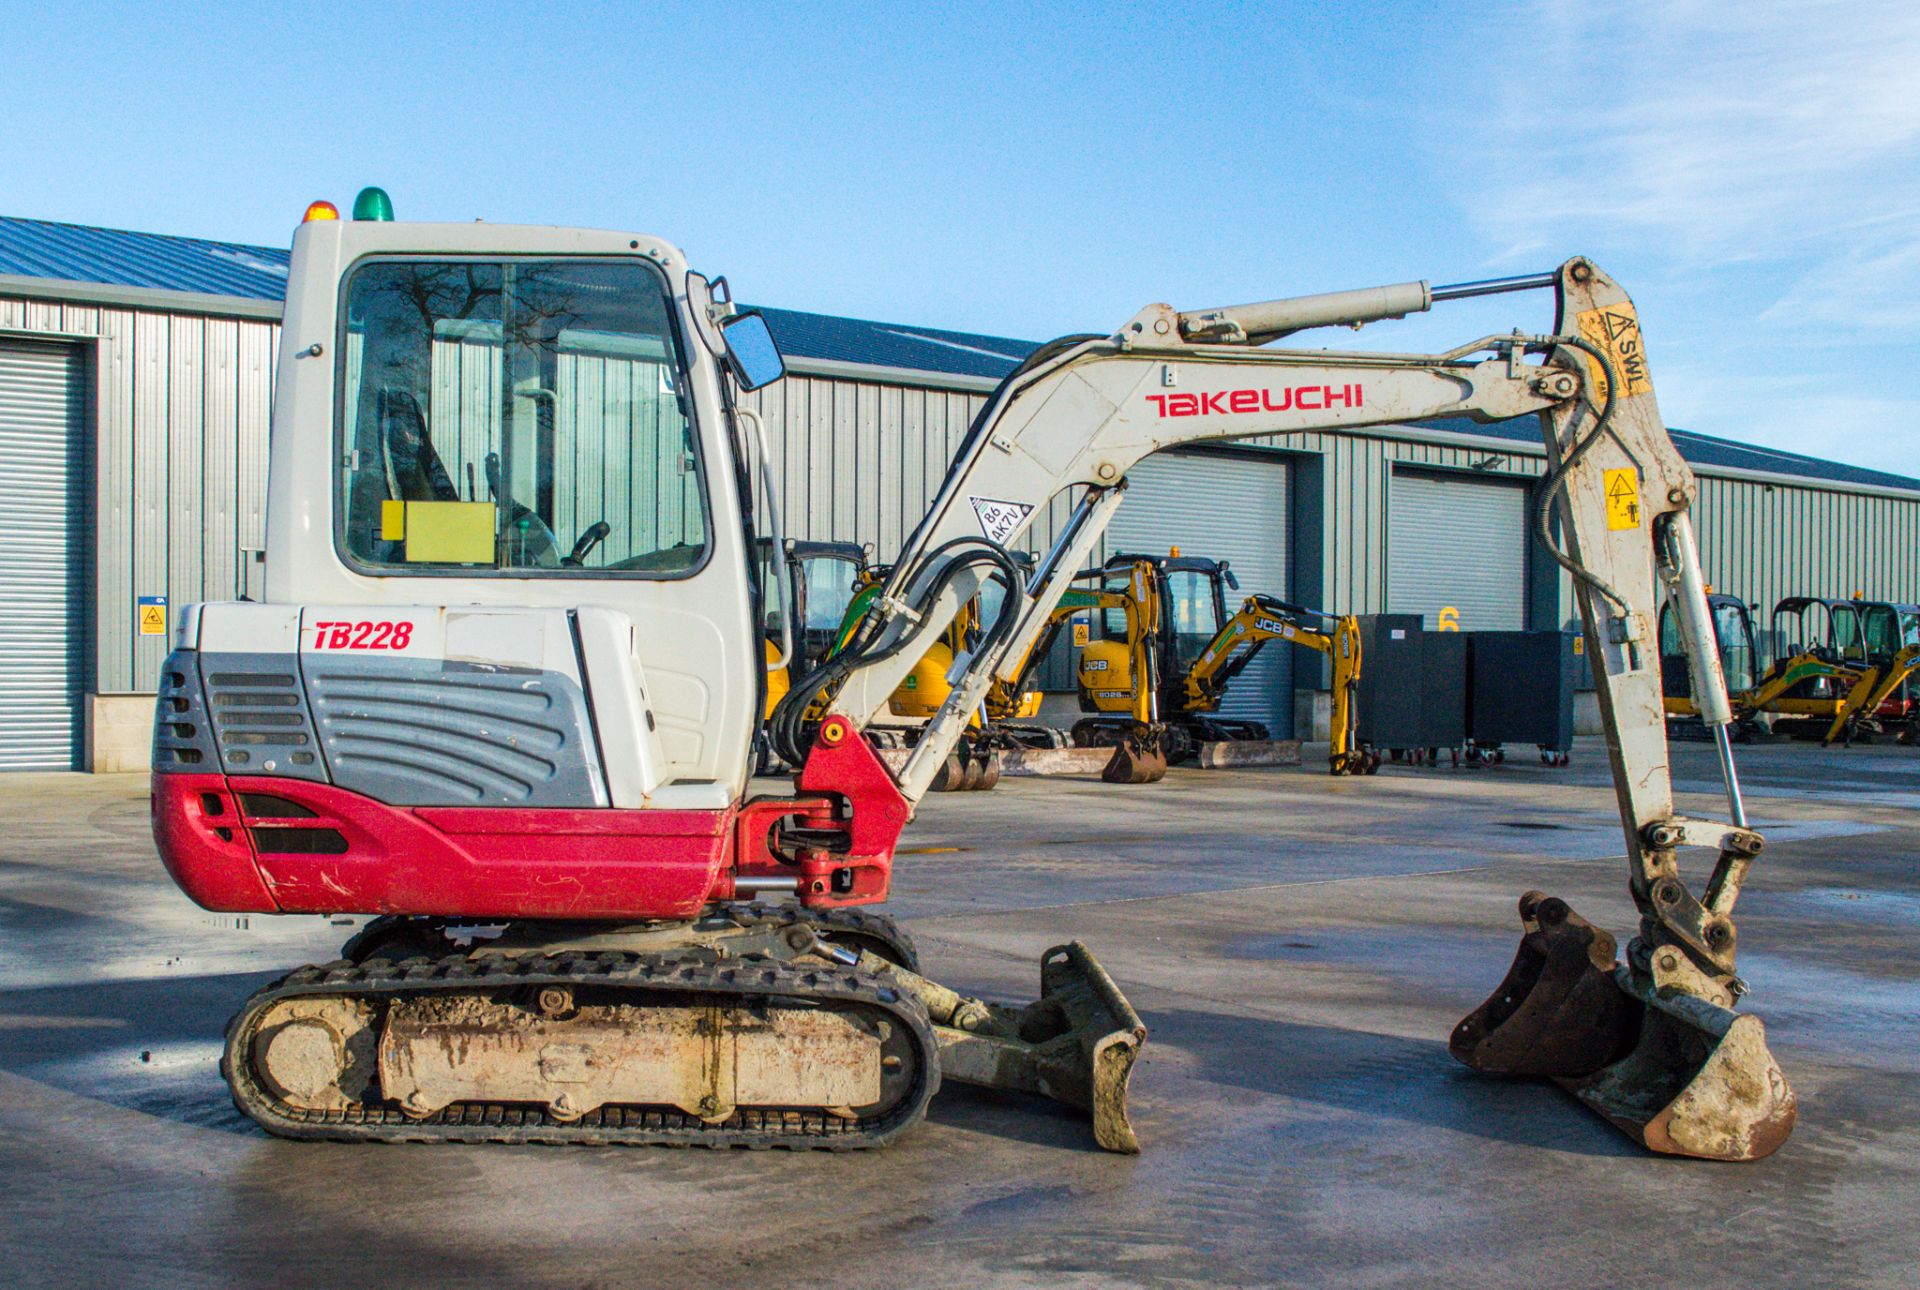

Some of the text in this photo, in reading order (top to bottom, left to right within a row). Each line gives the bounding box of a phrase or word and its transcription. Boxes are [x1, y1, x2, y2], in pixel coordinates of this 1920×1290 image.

[1619, 341, 1643, 390] SWL
[984, 507, 1000, 523] 86
[992, 508, 1019, 541] AK7V
[1255, 617, 1282, 634] JCB
[1438, 606, 1460, 632] 6
[314, 621, 414, 650] TB228
[1085, 660, 1107, 671] JCB
